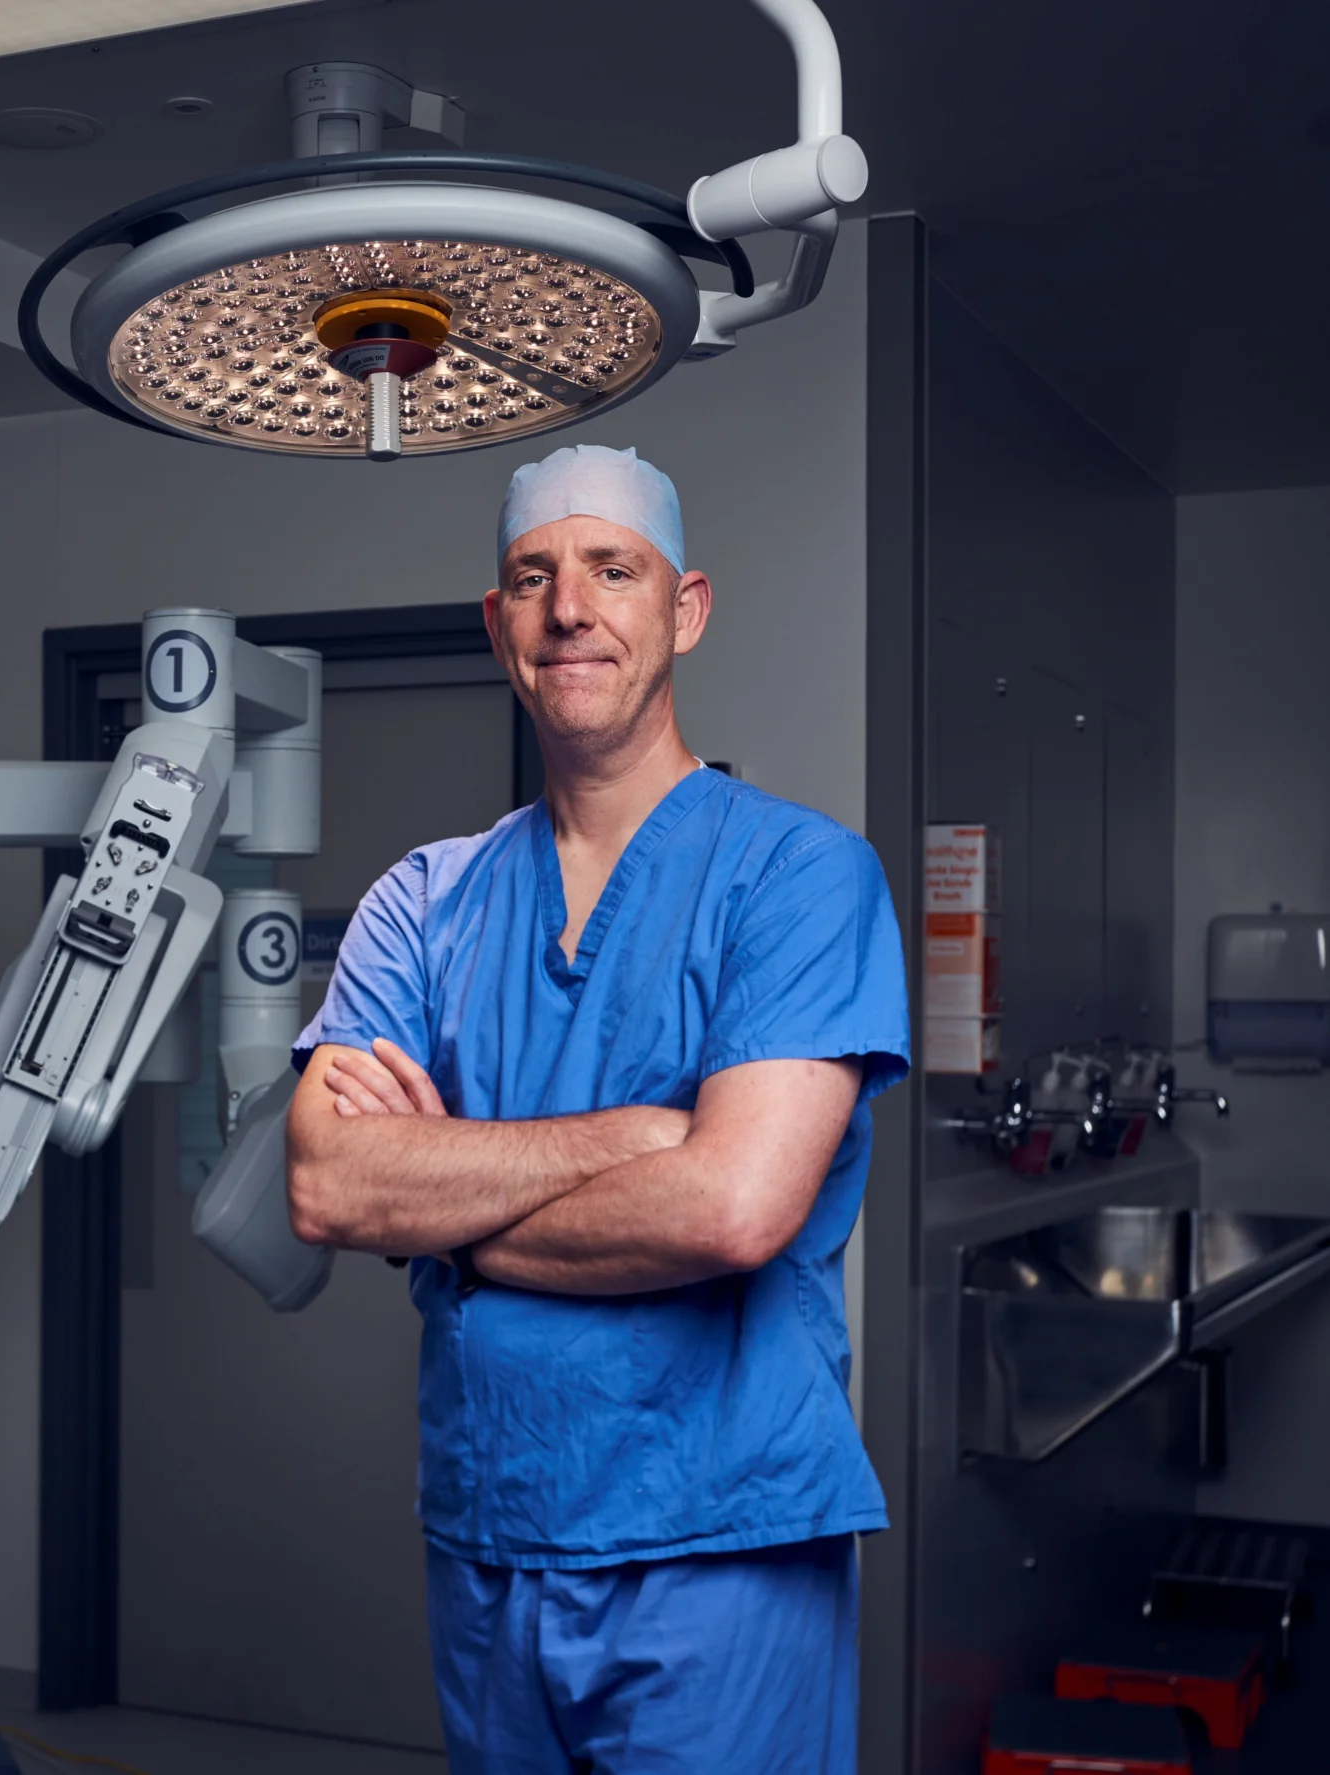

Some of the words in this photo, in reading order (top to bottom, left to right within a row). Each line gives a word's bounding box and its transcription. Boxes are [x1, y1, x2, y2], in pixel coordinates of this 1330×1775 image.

[165, 646, 183, 693] 1
[260, 926, 286, 968] 3
[306, 931, 343, 951] Dirt
